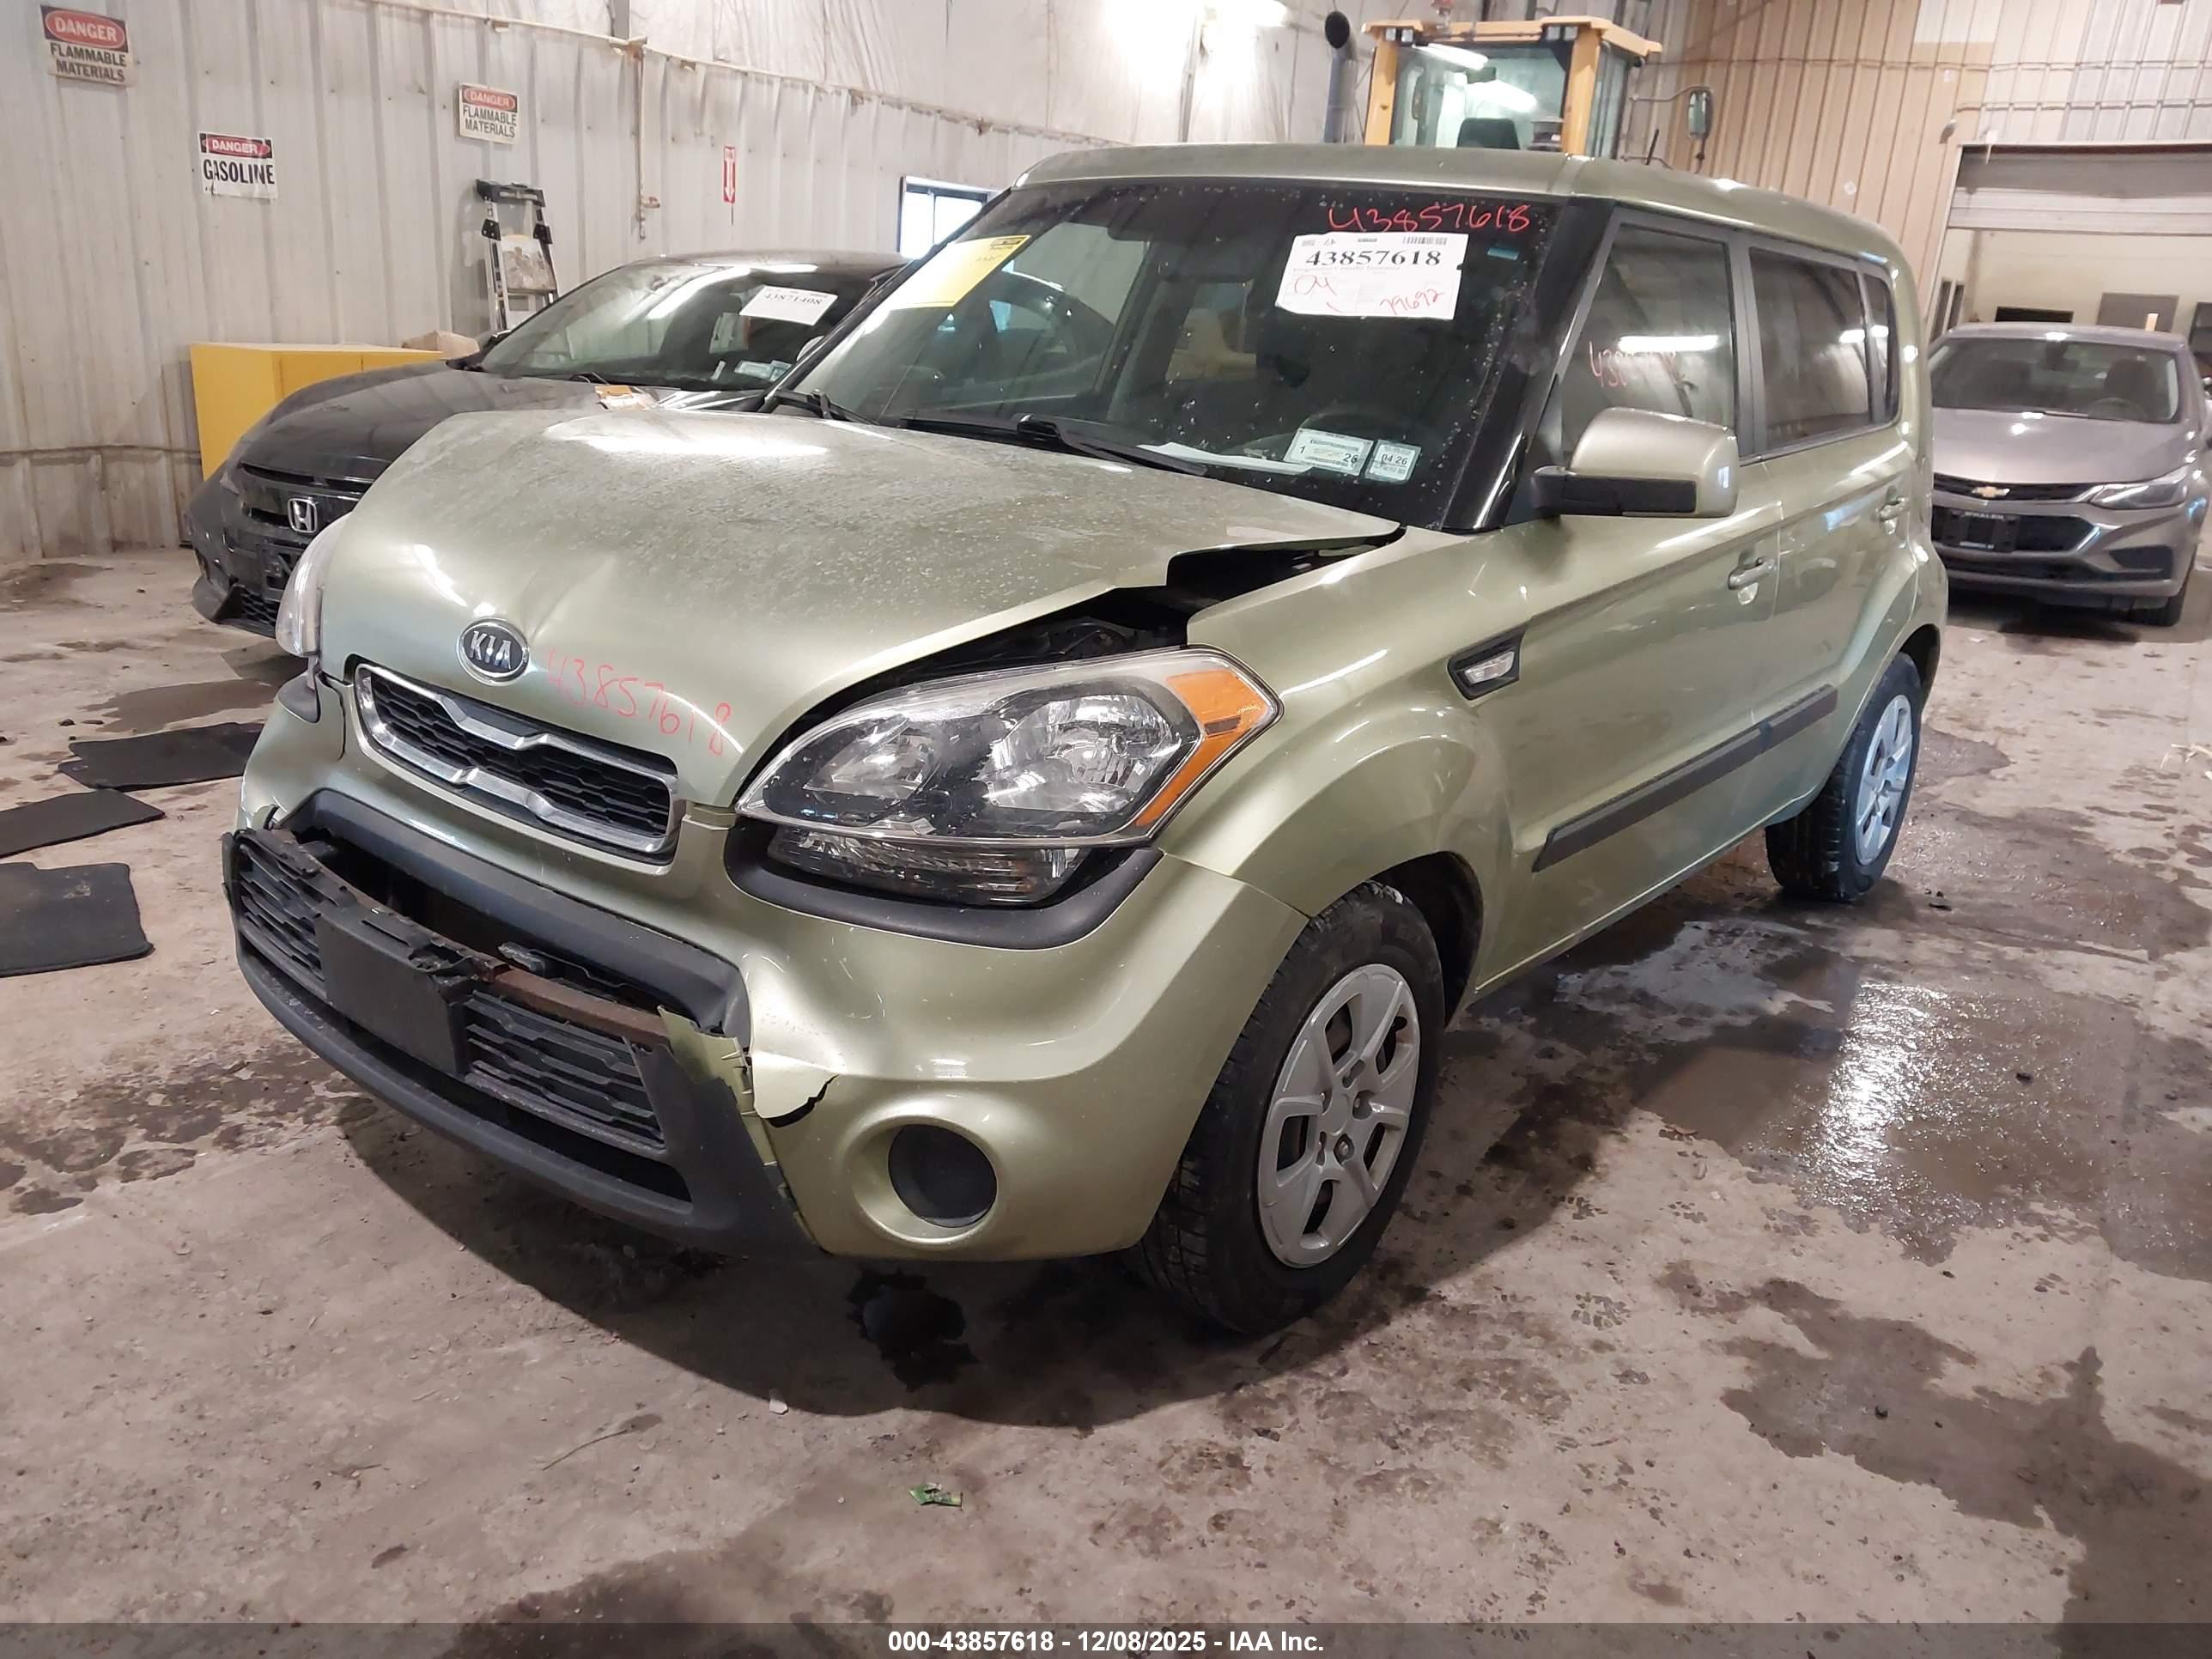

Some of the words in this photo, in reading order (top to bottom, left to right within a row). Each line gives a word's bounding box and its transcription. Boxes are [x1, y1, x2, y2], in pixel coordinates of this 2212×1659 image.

[54, 17, 118, 42] DANGER
[50, 42, 126, 67] FLAMMABLE
[56, 59, 125, 82] MATERIALS
[470, 90, 509, 107] DANGER
[463, 105, 517, 127] FLAMMABLE
[465, 118, 515, 138] MATERIALS
[212, 139, 258, 154] DANGER
[203, 159, 275, 185] GASOLINE
[1328, 202, 1531, 233] 43857618
[1305, 250, 1442, 266] 43857618
[1395, 455, 1407, 465] 26
[469, 630, 512, 670] KIA
[546, 648, 732, 756] 43857618
